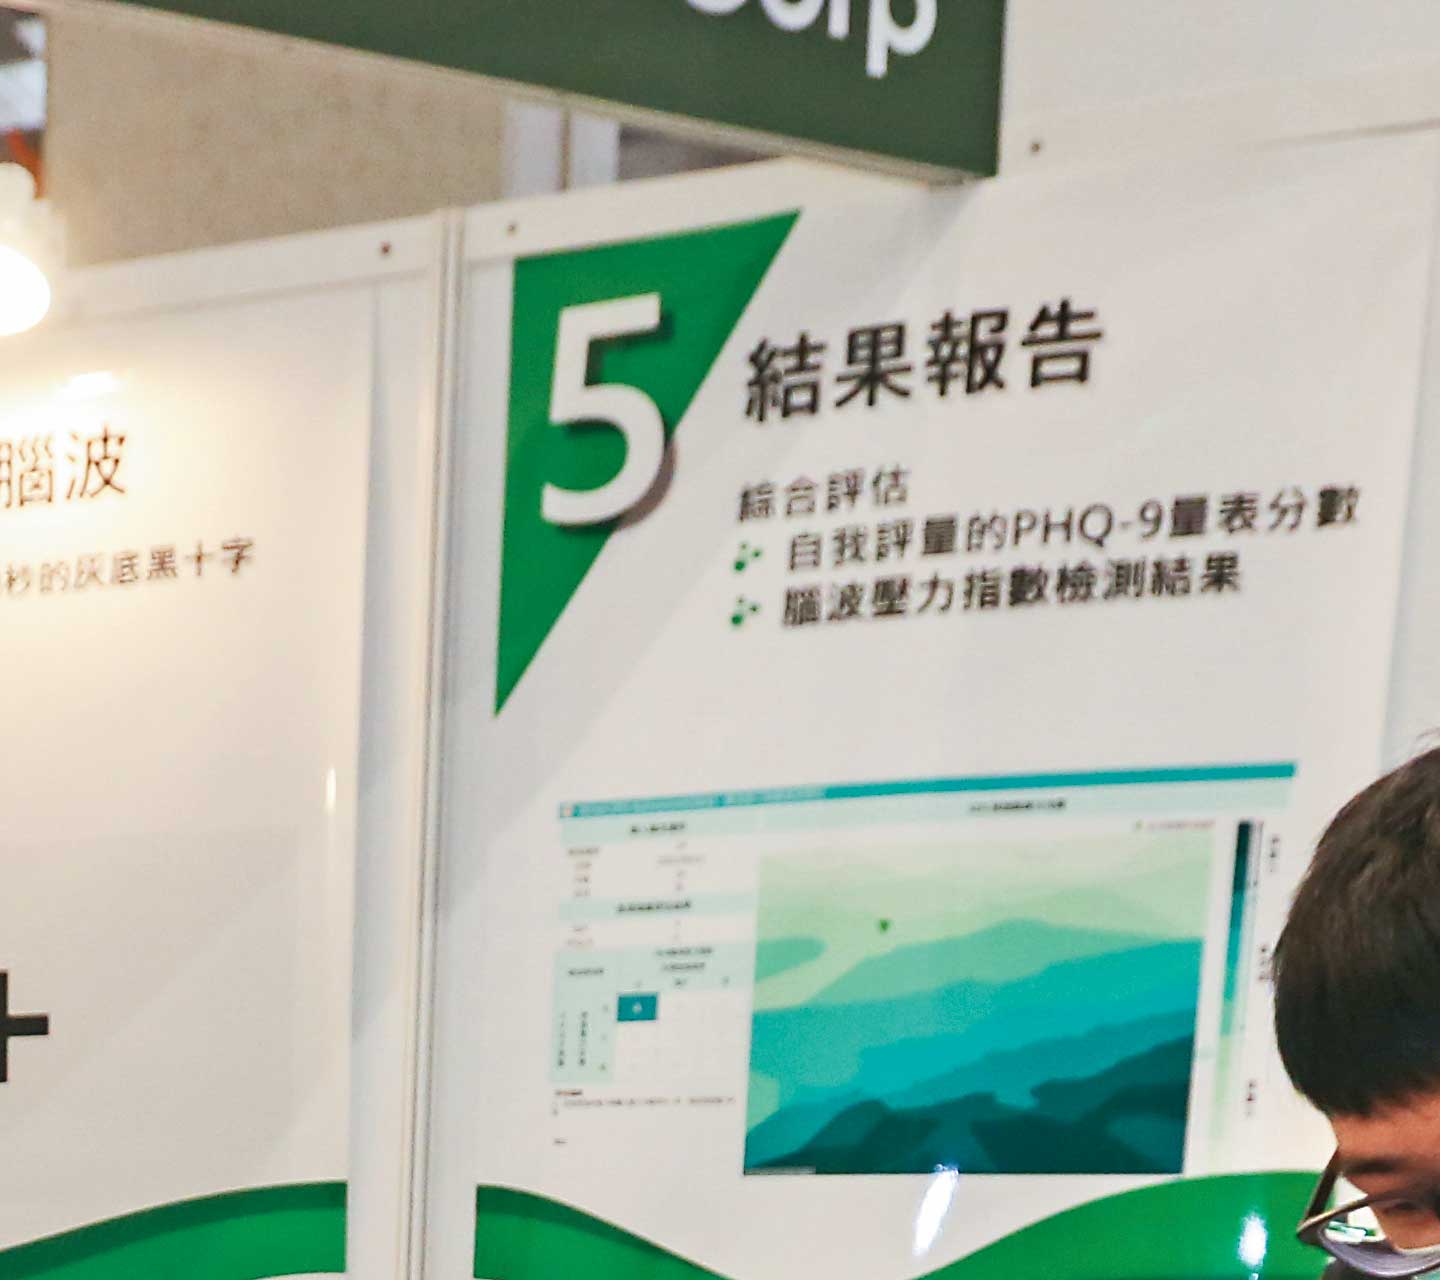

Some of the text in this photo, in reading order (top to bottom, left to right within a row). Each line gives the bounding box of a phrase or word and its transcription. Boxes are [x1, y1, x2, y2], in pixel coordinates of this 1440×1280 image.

[743, 297, 1106, 424] 結果報告
[540, 292, 666, 528] 5
[737, 466, 911, 524] 綜合評估
[786, 485, 1361, 574] 自我評量的PHQ-9量表分數
[780, 550, 1244, 631] 腦波壓力指數檢測結果
